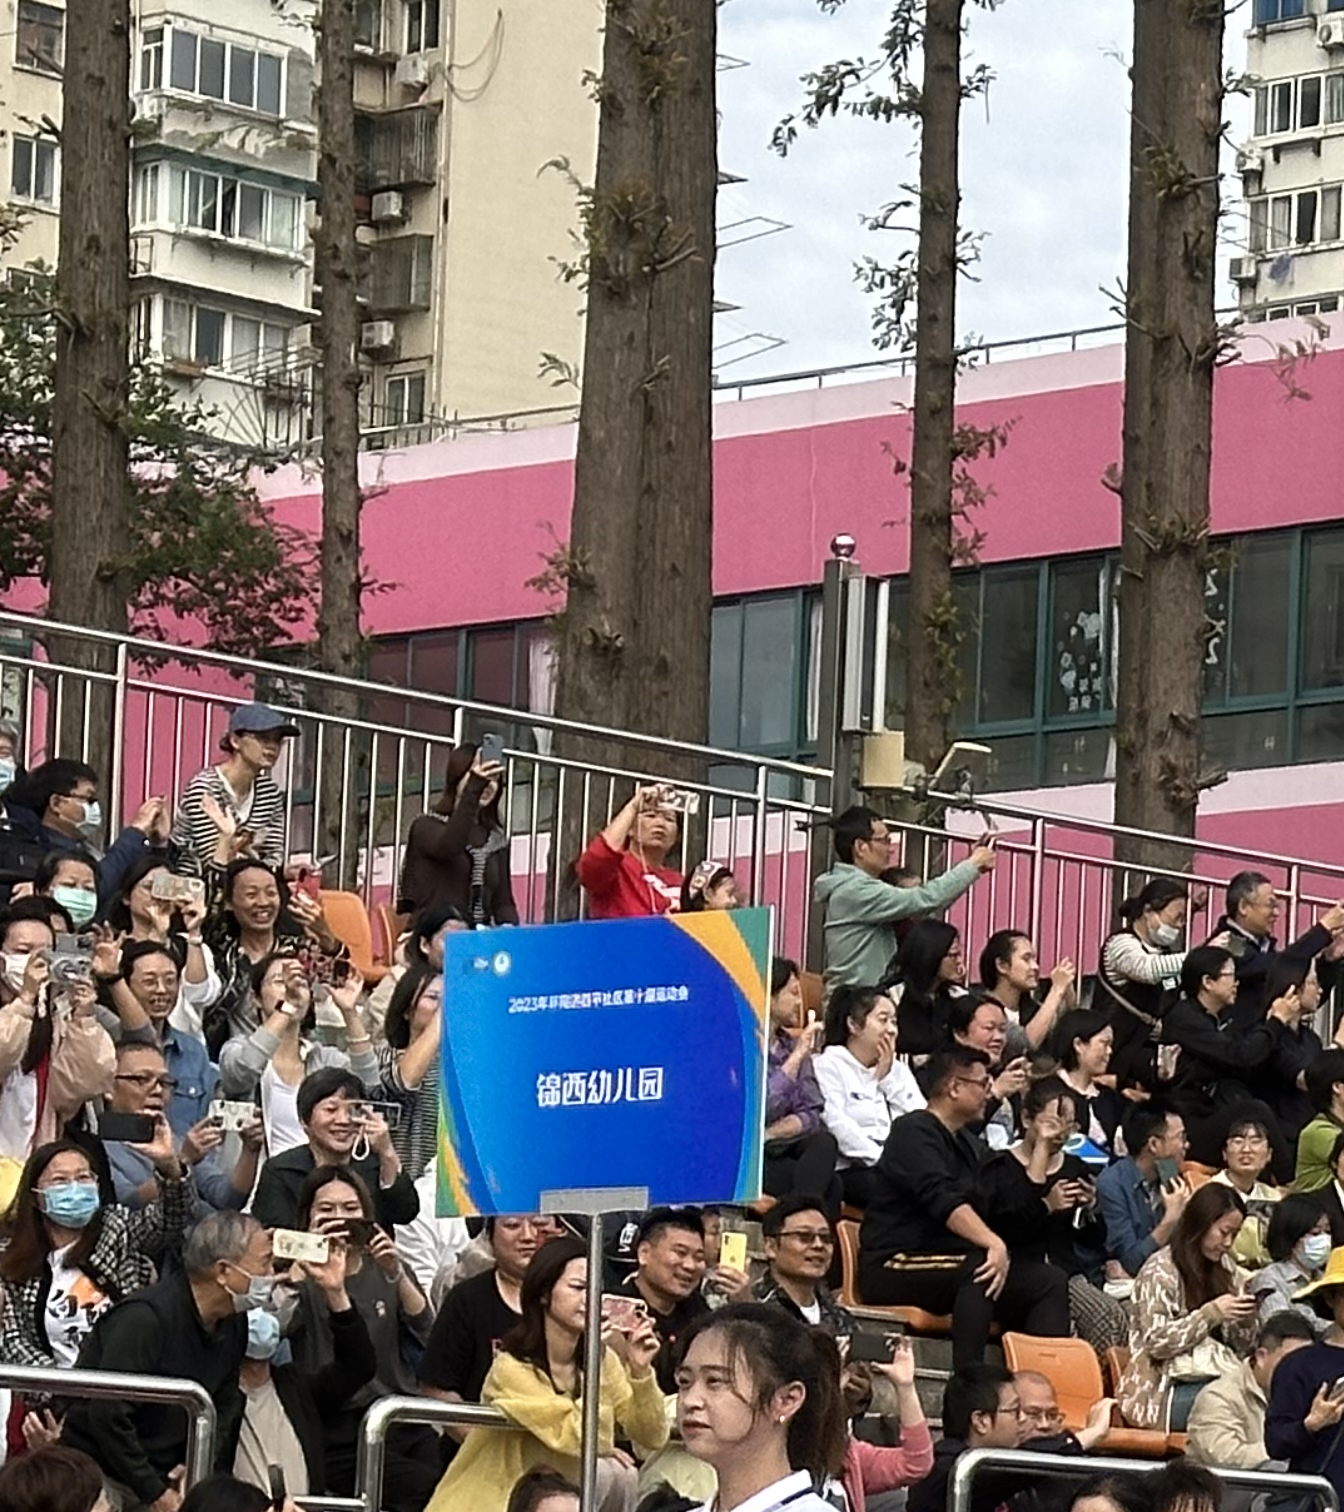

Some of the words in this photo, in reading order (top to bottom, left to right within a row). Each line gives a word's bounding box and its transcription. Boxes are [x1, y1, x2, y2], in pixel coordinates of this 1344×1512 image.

[537, 1068, 663, 1107] 锦西幼儿园
